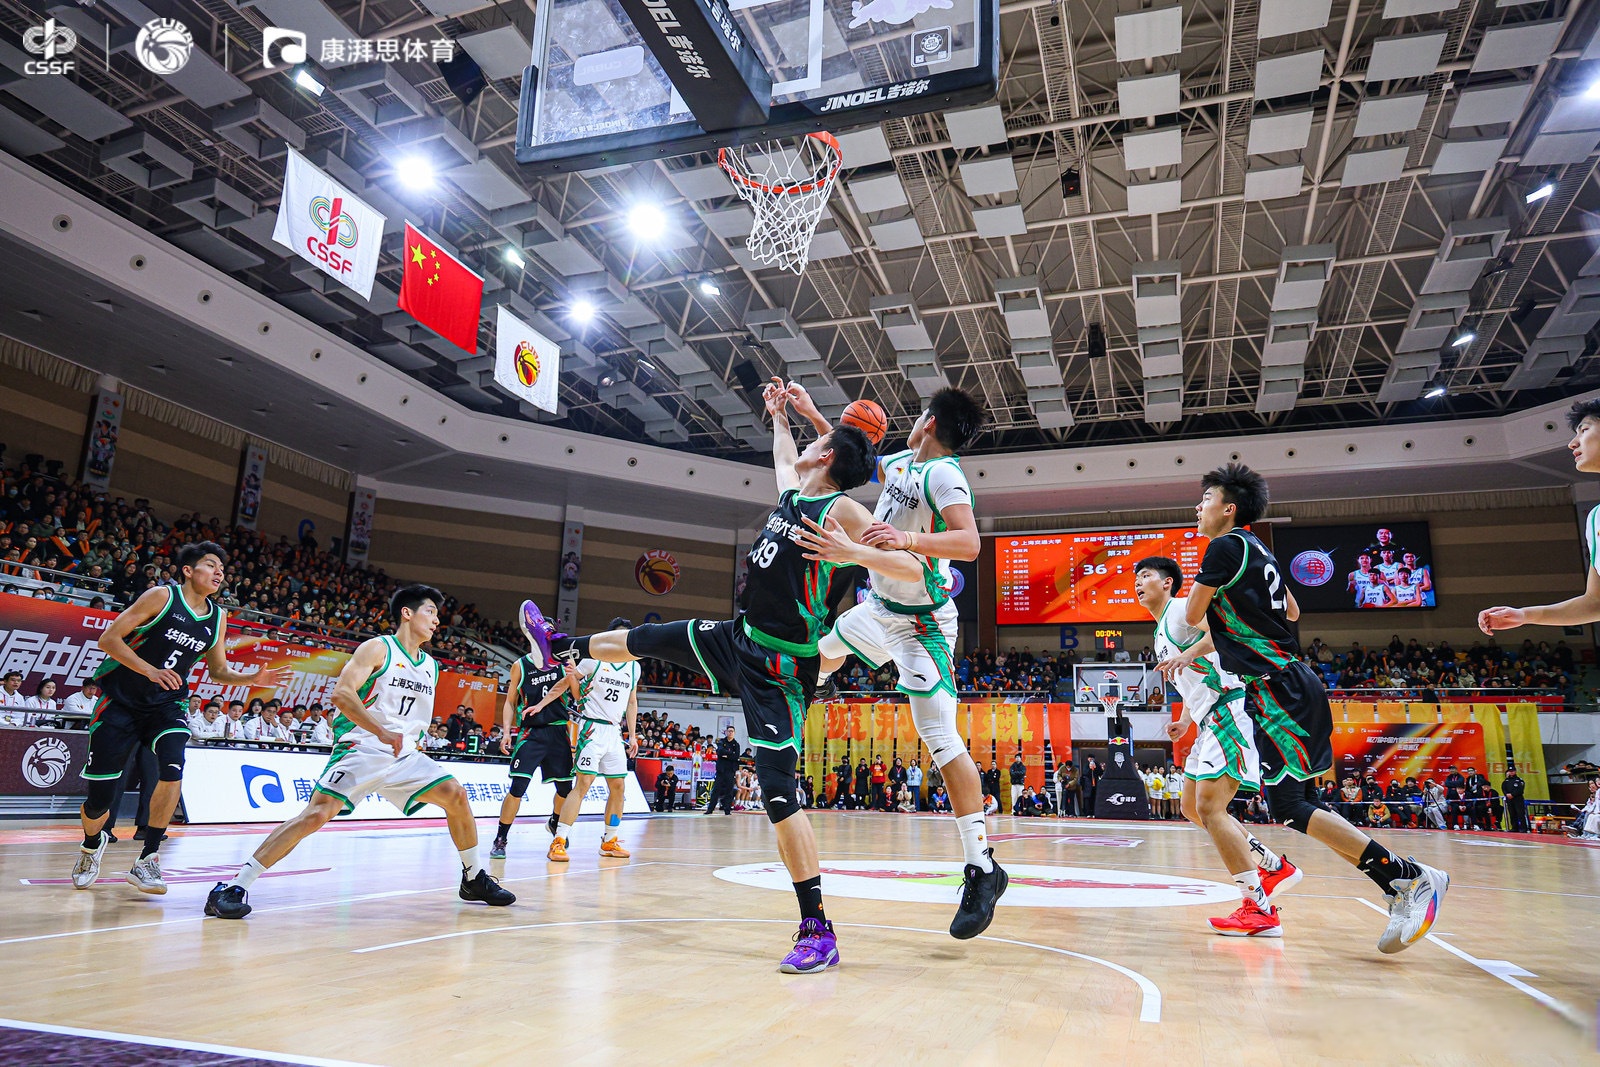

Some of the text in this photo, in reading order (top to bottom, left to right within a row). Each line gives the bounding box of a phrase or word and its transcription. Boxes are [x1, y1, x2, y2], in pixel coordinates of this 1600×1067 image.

[665, 35, 712, 79] 吉诺尔
[821, 79, 932, 112] JINOEL 吉诺尔
[305, 236, 354, 275] CSSF
[1083, 564, 1108, 576] 36
[1264, 563, 1288, 612] 2
[164, 627, 206, 653] 华侨大学
[1061, 626, 1079, 649] B
[164, 649, 183, 670] 5
[598, 675, 630, 689] 上海交通大学
[397, 695, 416, 717] 17
[604, 688, 619, 703] 25
[467, 735, 479, 753] 3
[513, 759, 520, 769] 6
[580, 756, 592, 767] 25
[328, 770, 346, 784] 17
